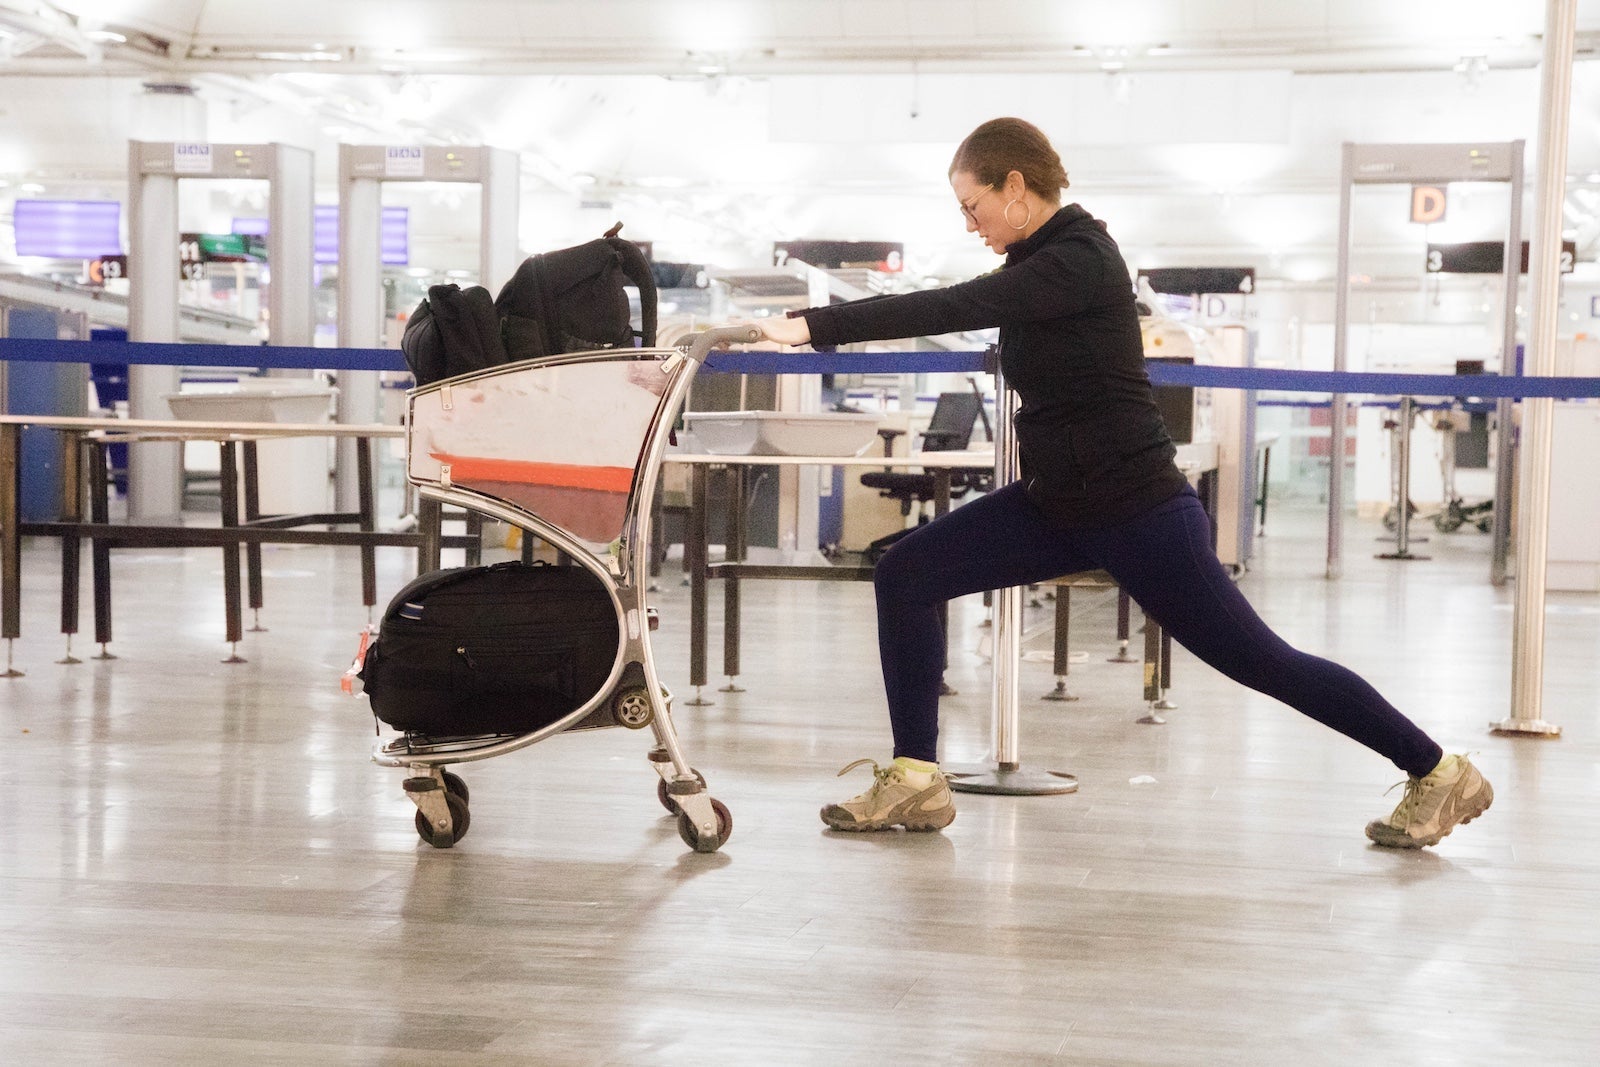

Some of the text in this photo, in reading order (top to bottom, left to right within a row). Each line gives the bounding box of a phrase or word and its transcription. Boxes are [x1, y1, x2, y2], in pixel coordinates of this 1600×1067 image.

[1413, 186, 1446, 222] D
[180, 241, 200, 261] 11
[775, 250, 788, 268] 7
[1428, 250, 1442, 271] 3
[1560, 251, 1573, 271] 2
[1238, 275, 1252, 293] 4
